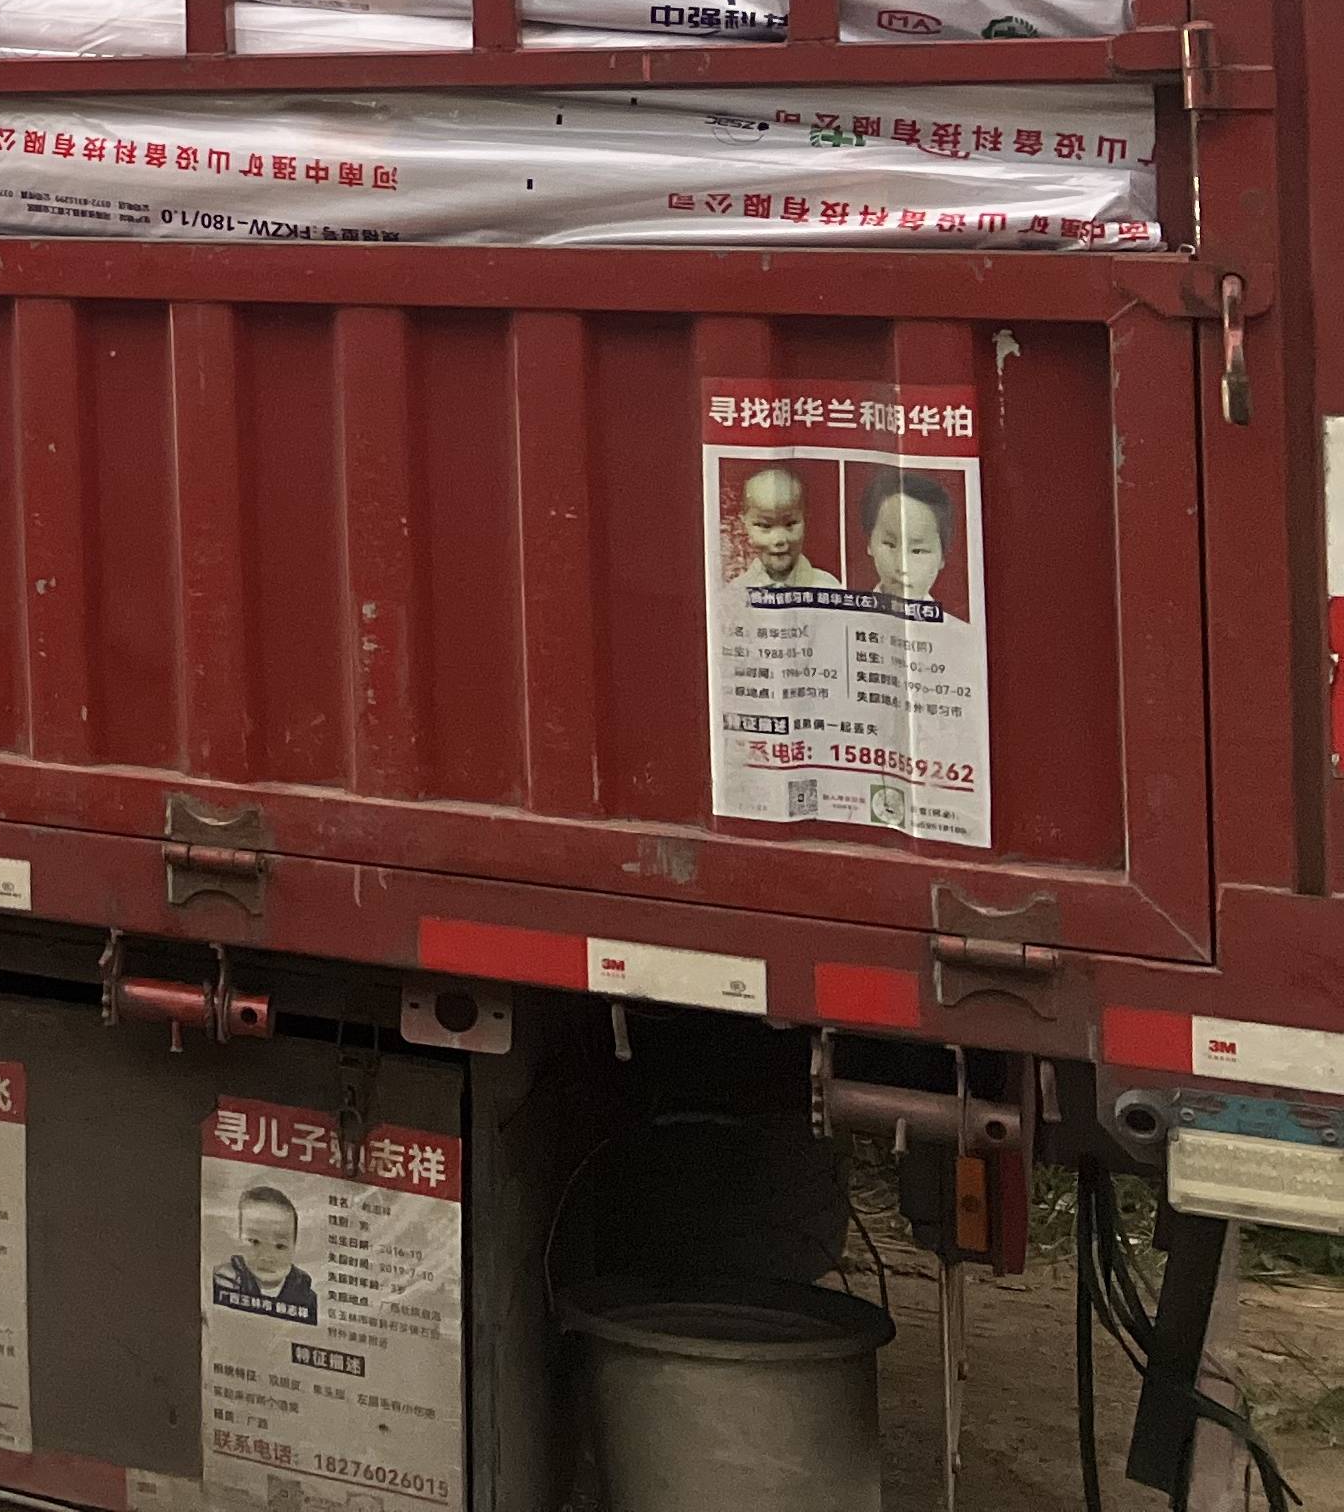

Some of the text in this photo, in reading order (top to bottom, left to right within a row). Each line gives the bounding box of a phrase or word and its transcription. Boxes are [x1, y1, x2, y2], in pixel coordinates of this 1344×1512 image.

[887, 14, 930, 30] MA
[709, 396, 974, 437] 寻找胡华兰和胡华柏
[1209, 1040, 1236, 1055] 3M
[214, 1110, 446, 1187] 寻儿子志祥
[295, 1345, 362, 1376] 特征描述
